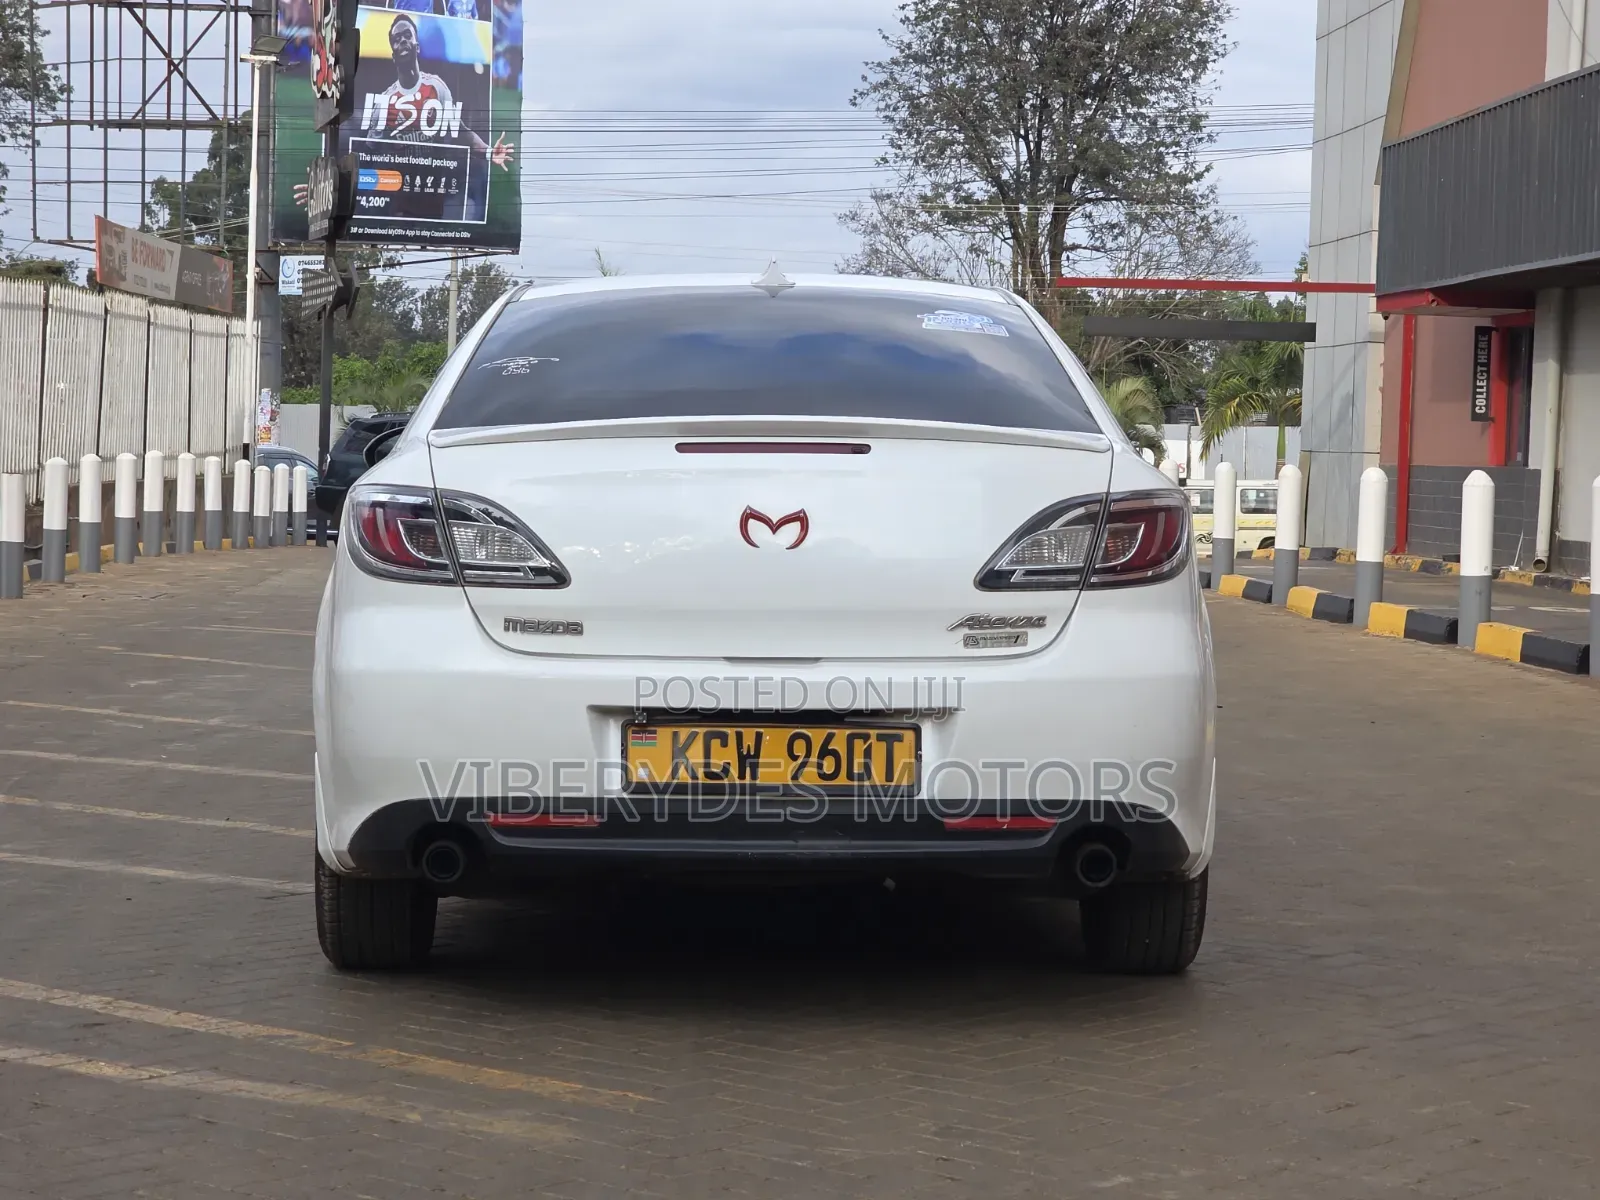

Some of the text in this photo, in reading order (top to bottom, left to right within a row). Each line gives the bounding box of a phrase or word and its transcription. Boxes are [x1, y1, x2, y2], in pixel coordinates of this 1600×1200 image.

[361, 92, 463, 138] IT'S ON
[359, 153, 458, 169] The world's best football package
[360, 196, 386, 208] 4,200
[406, 229, 415, 237] App
[1475, 335, 1488, 413] COLLECT HERE
[671, 729, 764, 782] KCW
[786, 730, 904, 783] 960T
